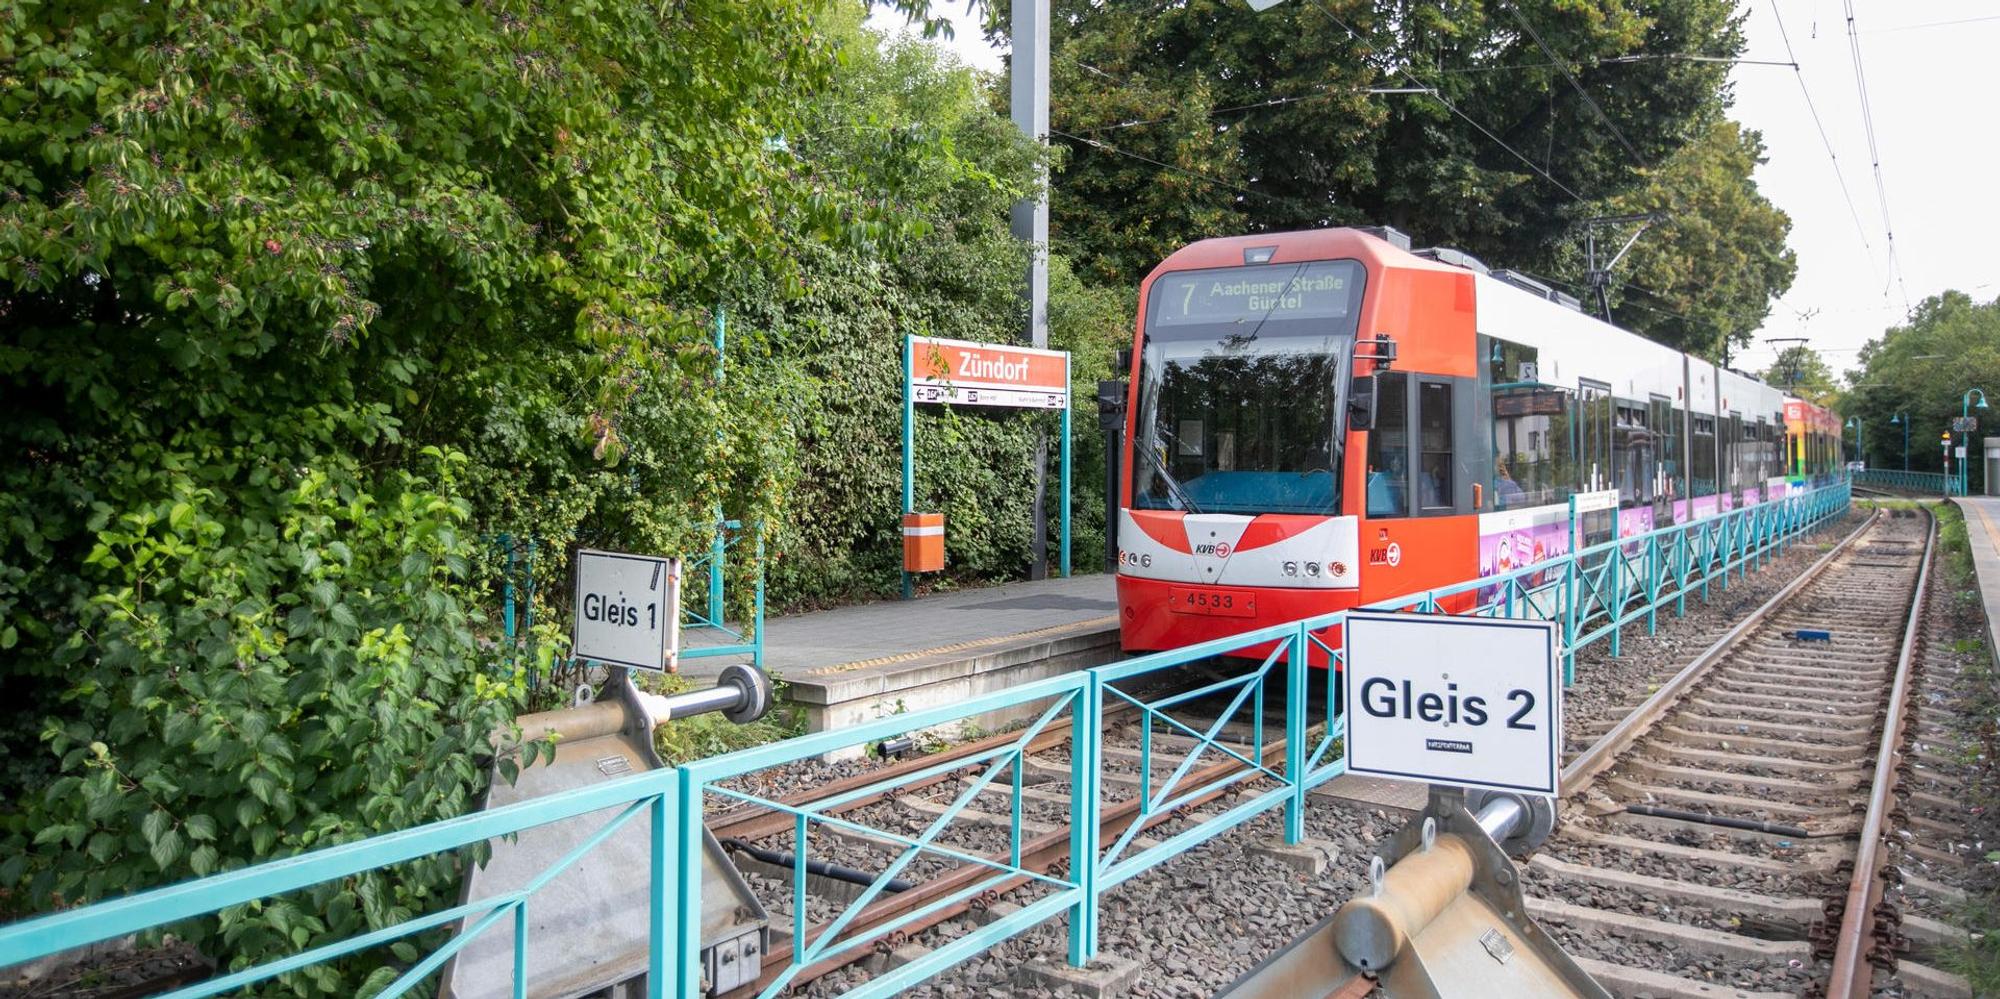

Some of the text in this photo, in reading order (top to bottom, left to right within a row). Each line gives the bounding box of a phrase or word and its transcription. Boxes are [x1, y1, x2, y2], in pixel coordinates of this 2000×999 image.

[1181, 275, 1344, 315] 7 Aachener Straße
[1249, 293, 1302, 310] Gürtel
[959, 351, 1029, 381] Zündorf
[1196, 544, 1215, 554] KVB
[1370, 548, 1387, 562] KVB
[583, 593, 656, 629] Gleis 1
[1187, 593, 1233, 608] 4533
[1360, 676, 1536, 731] Gleis 2
